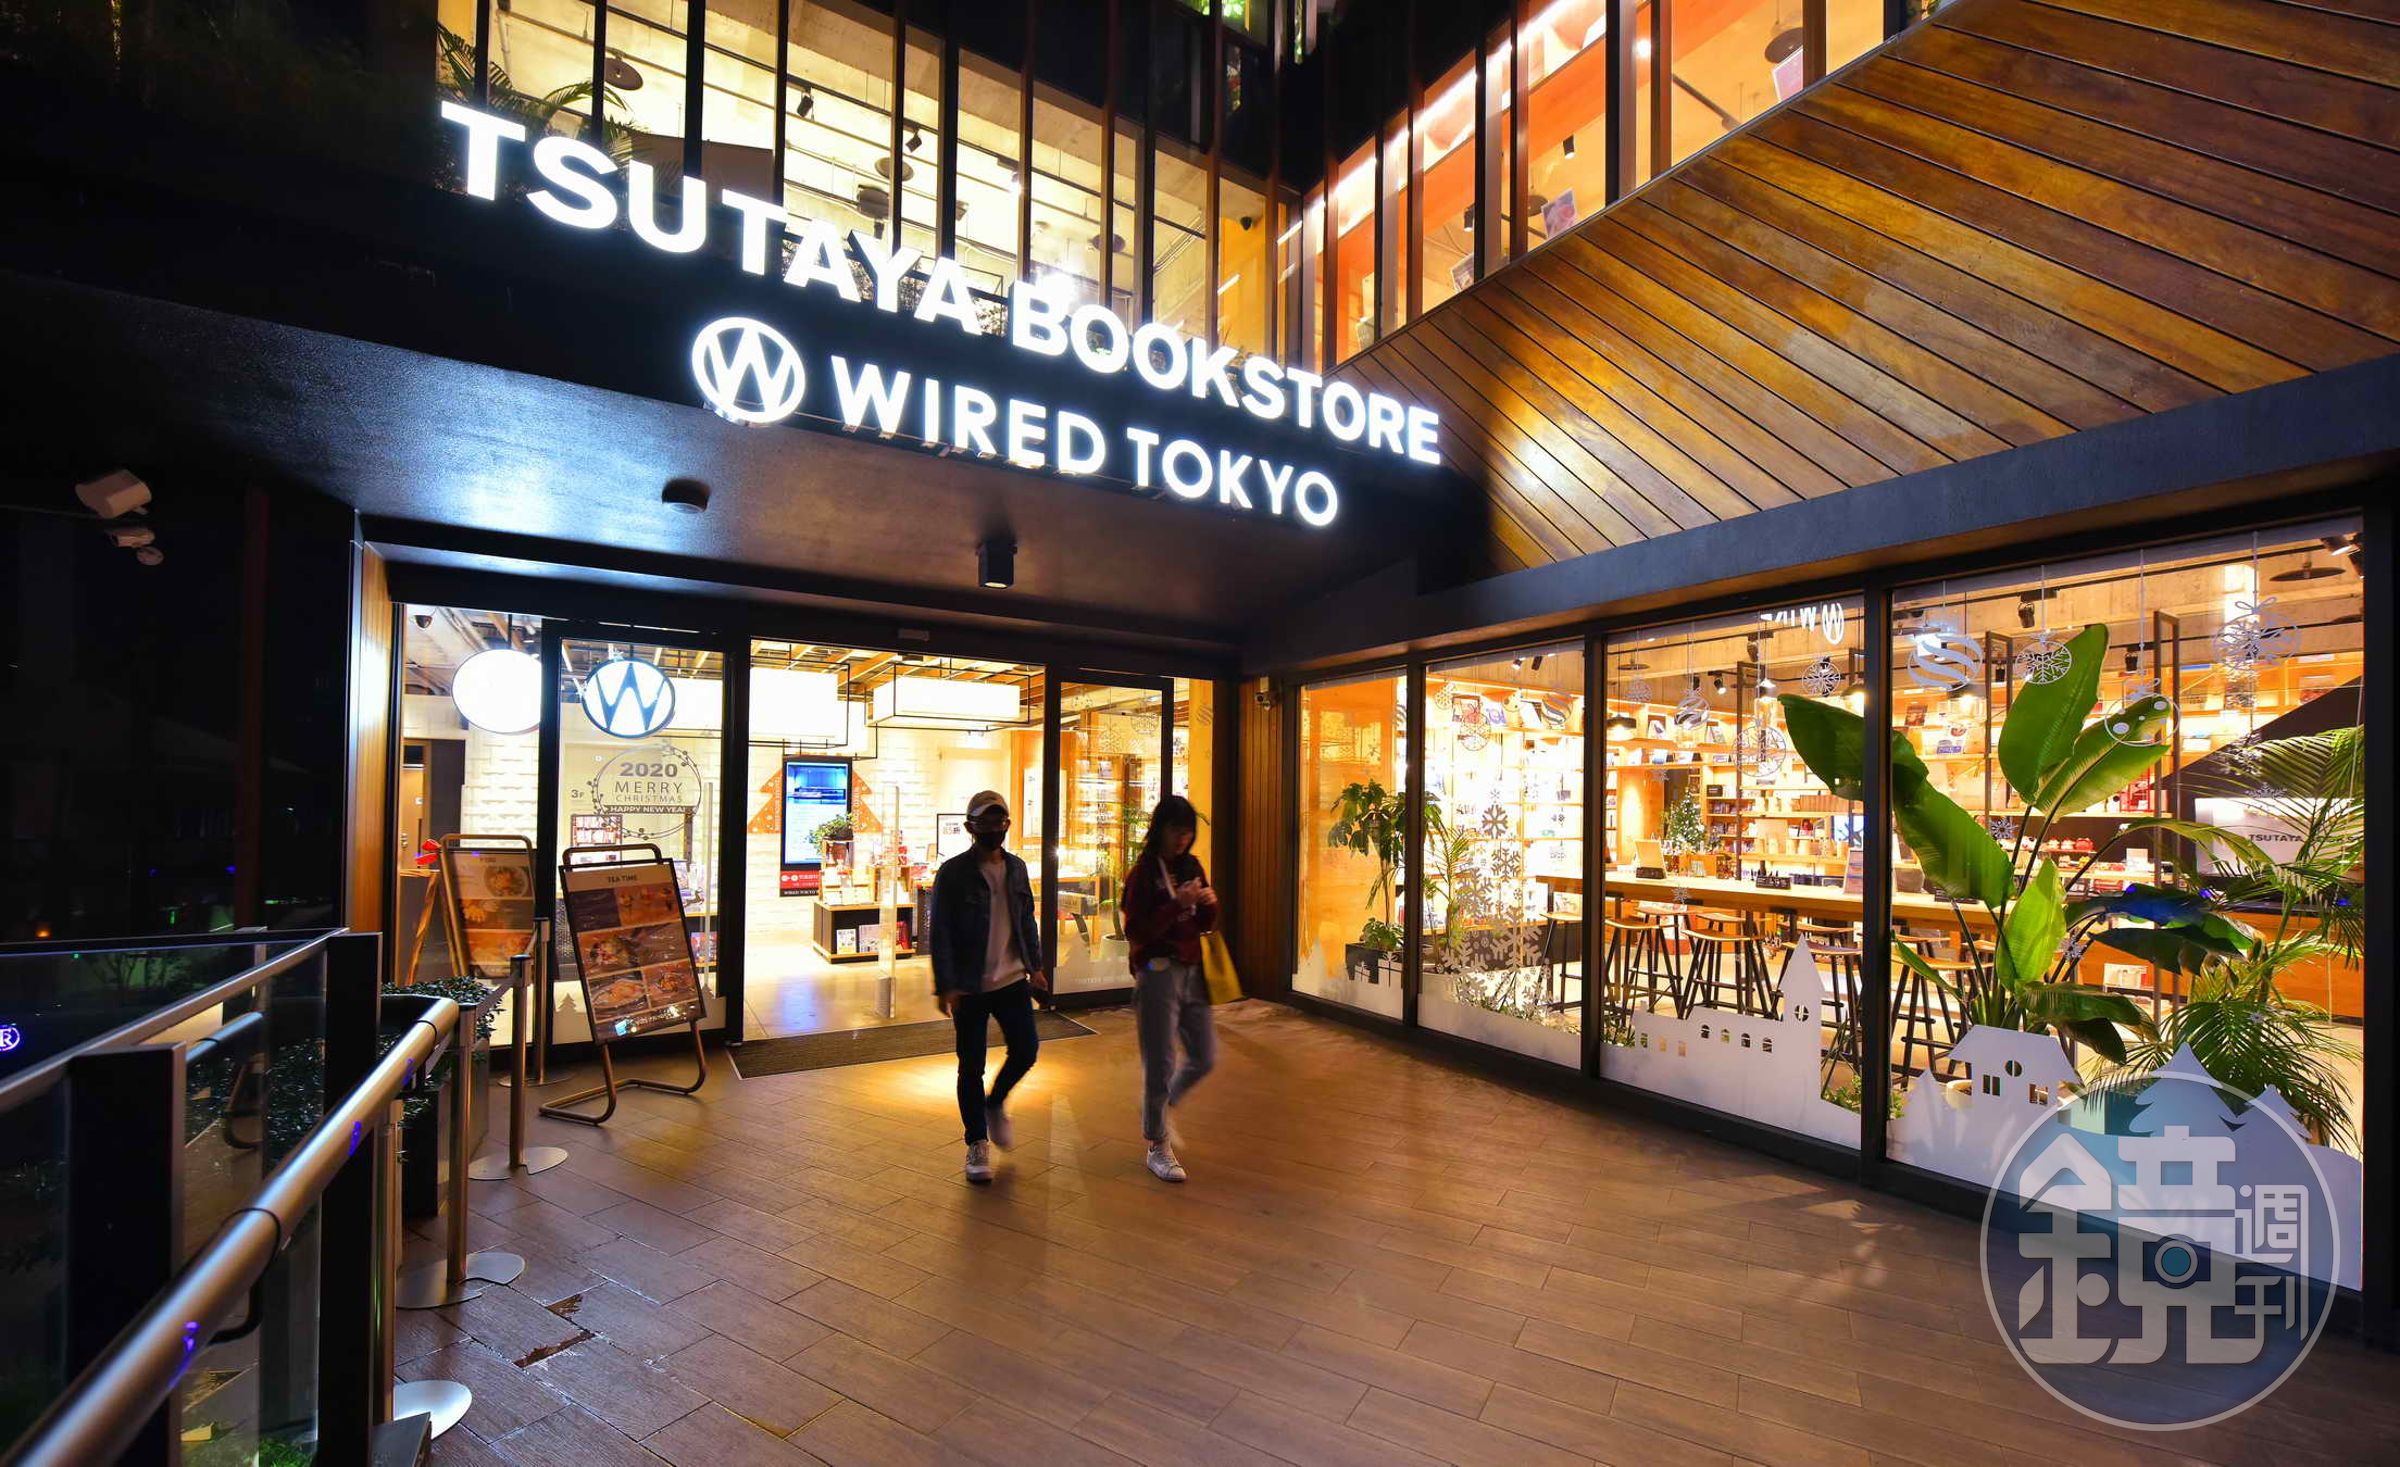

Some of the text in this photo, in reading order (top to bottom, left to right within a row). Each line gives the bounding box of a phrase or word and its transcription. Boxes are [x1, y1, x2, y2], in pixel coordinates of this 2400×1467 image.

[441, 101, 1441, 465] TSUTAYA BOOKSTORE
[831, 356, 1106, 475] WIRED
[1126, 426, 1339, 527] TOKYO
[619, 762, 678, 778] 2020
[615, 781, 683, 794] MERRY
[615, 795, 684, 803] CHRISTMAS
